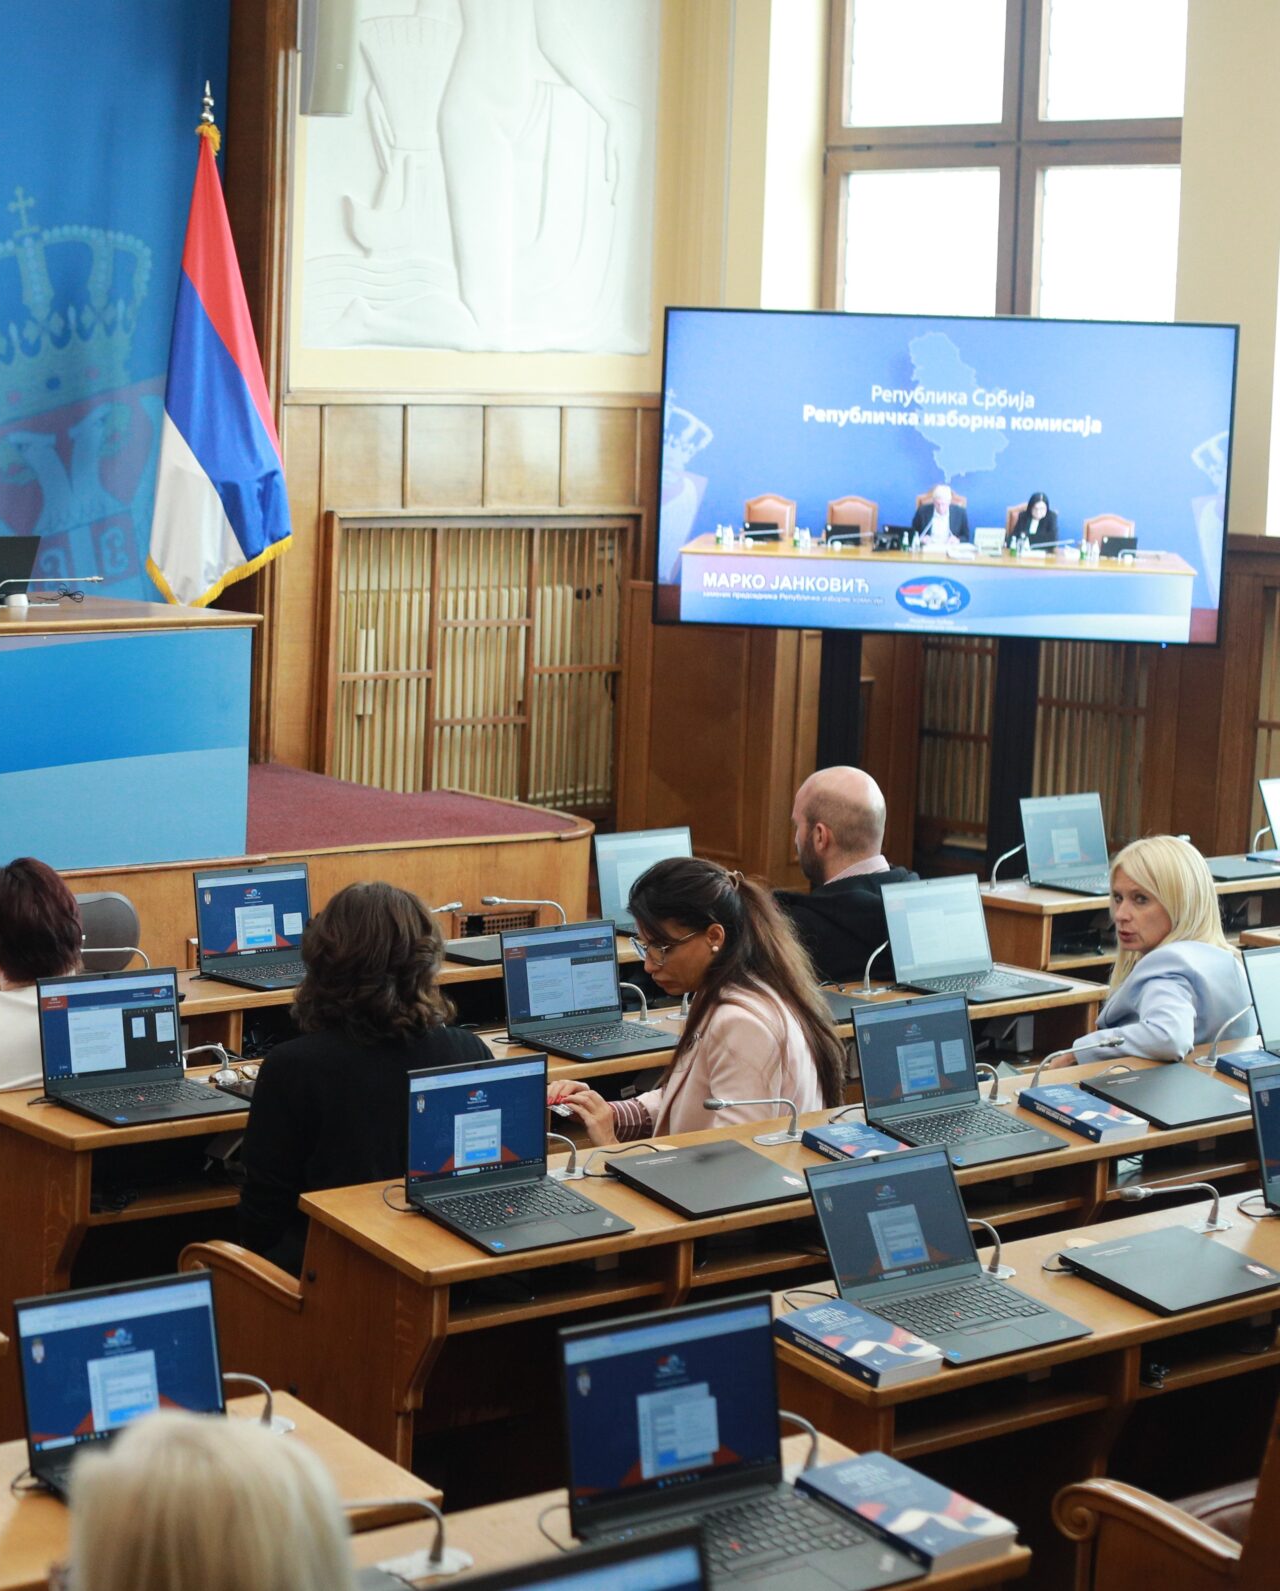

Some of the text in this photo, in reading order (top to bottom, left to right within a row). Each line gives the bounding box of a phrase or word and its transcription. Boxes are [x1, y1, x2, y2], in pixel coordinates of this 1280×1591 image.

[872, 385, 1036, 412] Република Србија
[803, 404, 1103, 438] Републичка изборна комисија
[703, 572, 870, 593] МАРКО ЈАНКОВИЋ
